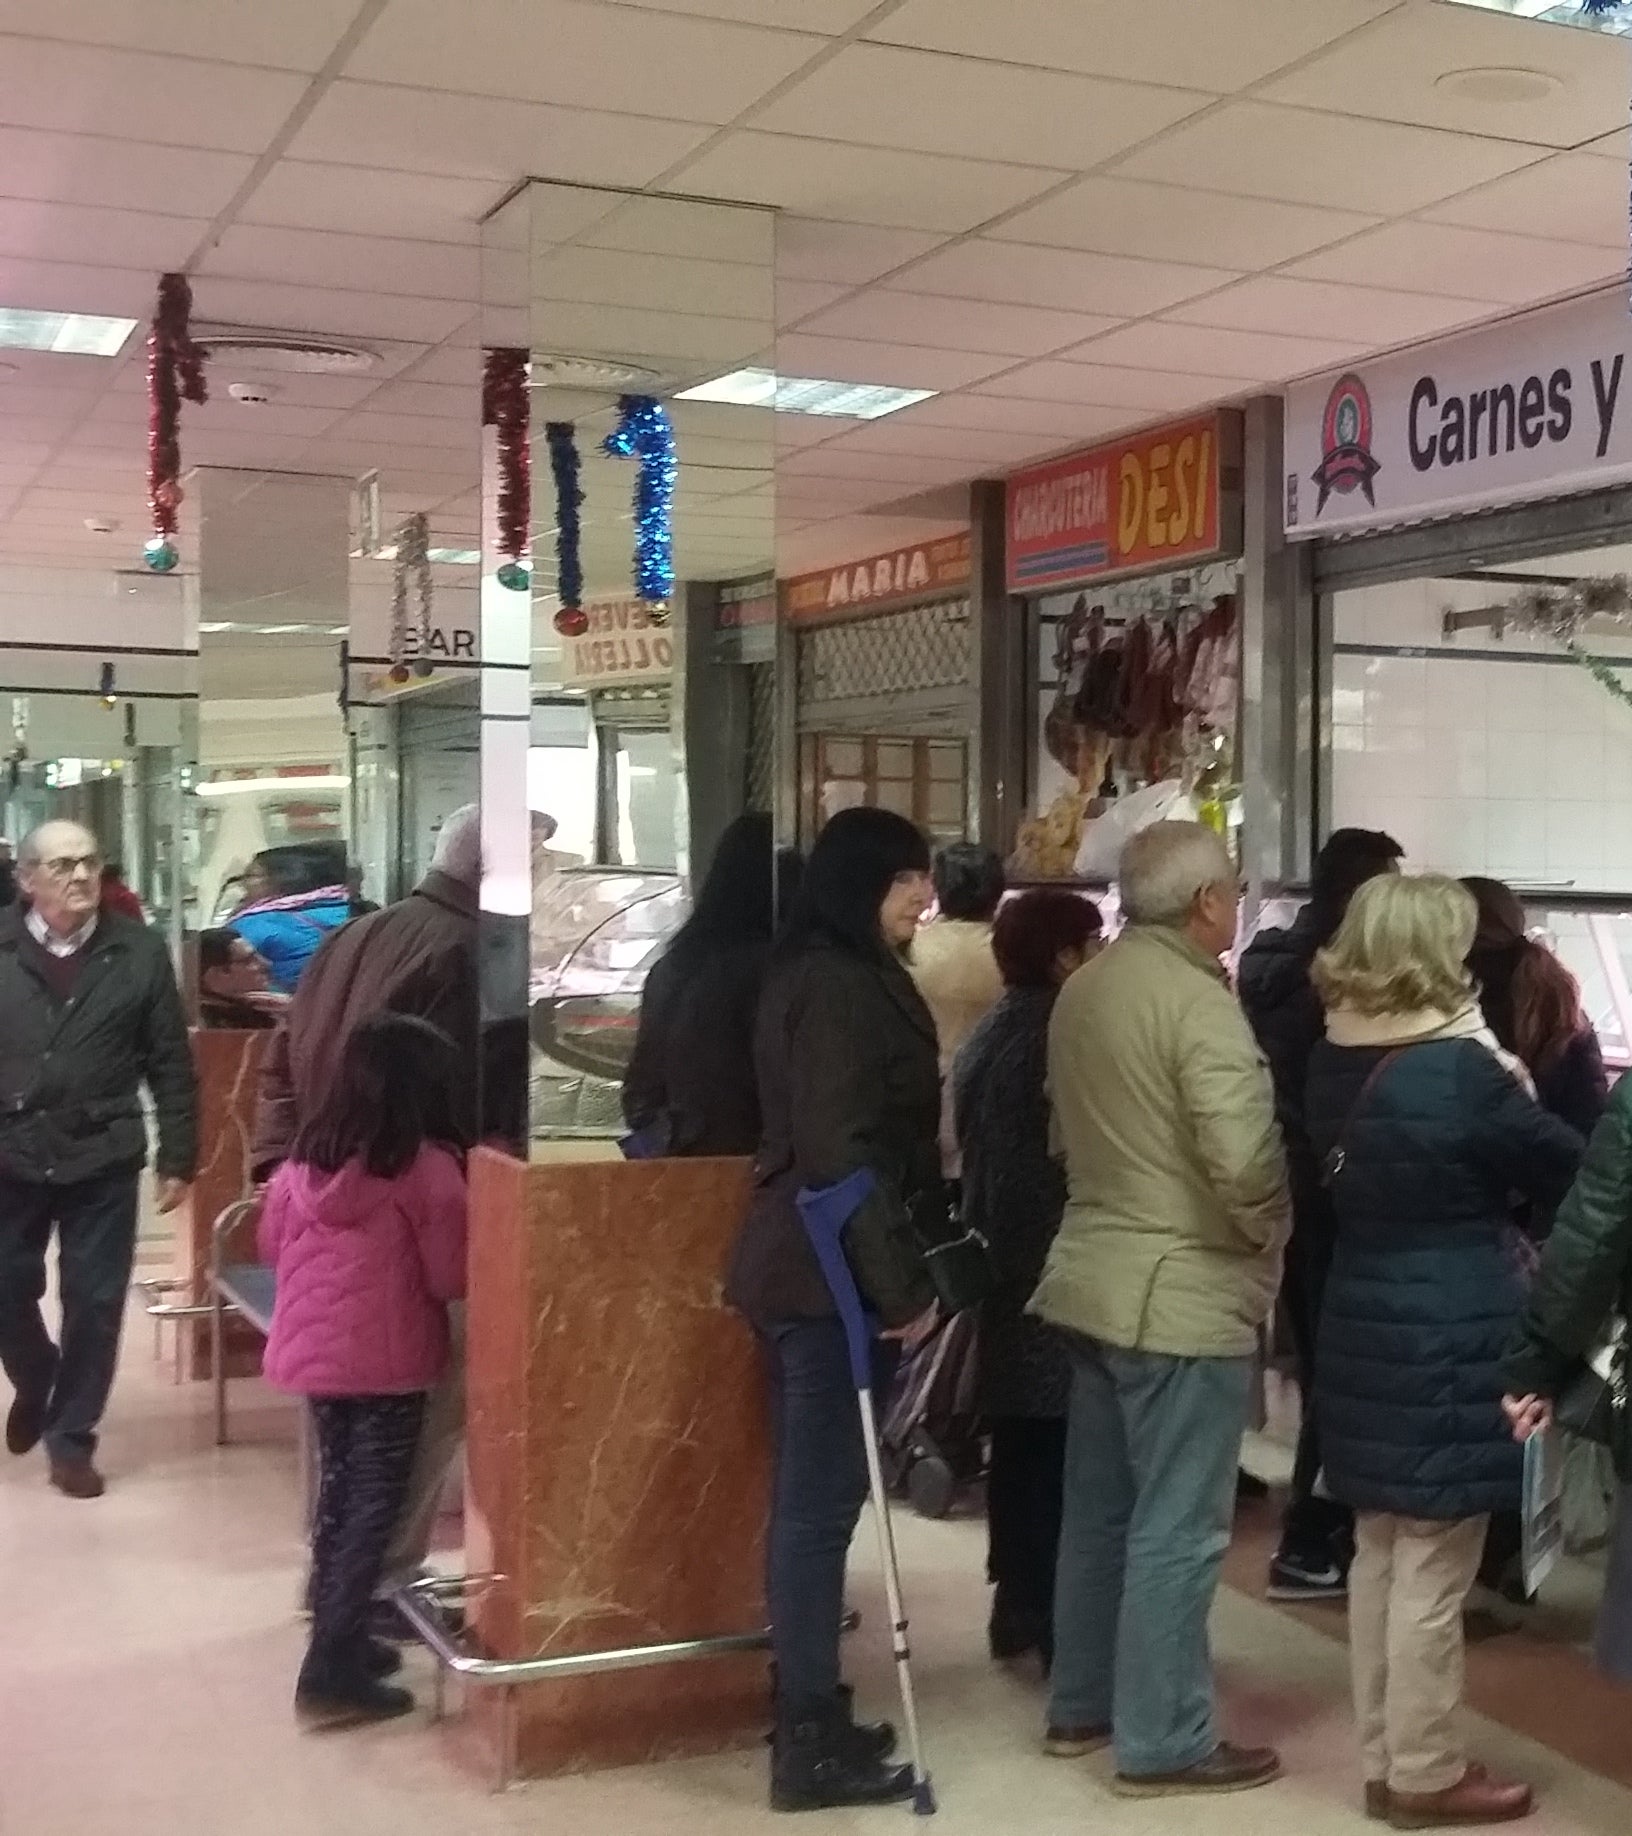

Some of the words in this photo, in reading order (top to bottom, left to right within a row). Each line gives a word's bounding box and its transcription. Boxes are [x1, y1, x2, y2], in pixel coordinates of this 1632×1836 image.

[1408, 364, 1572, 472] Carnes
[1590, 352, 1624, 458] y
[1118, 430, 1211, 555] DESI
[827, 550, 930, 608] MARIA
